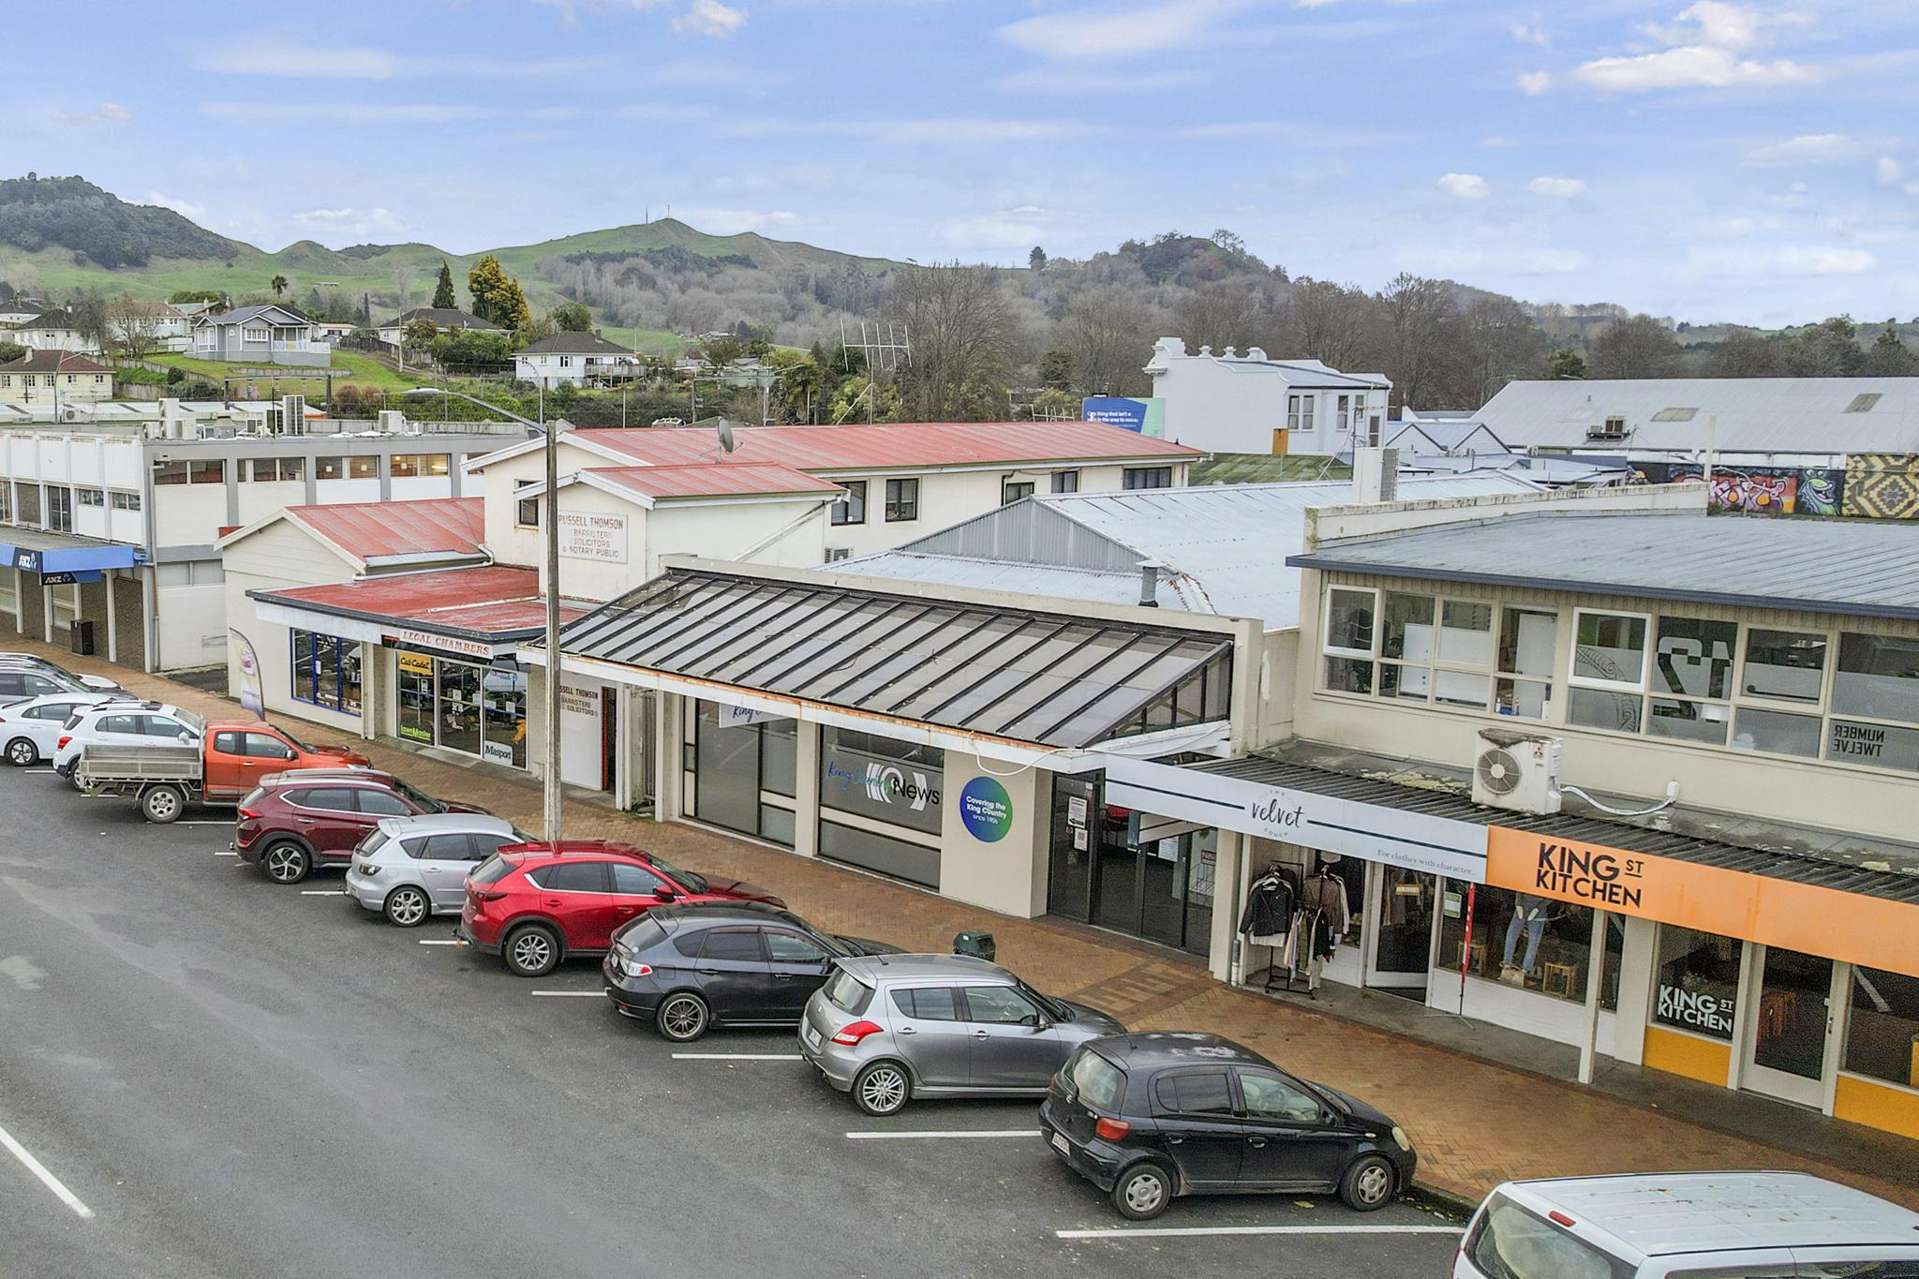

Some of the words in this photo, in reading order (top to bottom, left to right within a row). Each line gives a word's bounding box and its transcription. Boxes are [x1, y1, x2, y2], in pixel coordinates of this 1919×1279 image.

[590, 516, 624, 529] THOMSON
[569, 546, 593, 555] NOTARY
[596, 547, 619, 558] PUBLIC
[402, 630, 432, 645] LEGAL
[435, 636, 490, 656] CHAMBERS
[891, 776, 941, 806] News
[966, 795, 995, 810] Covering
[966, 803, 981, 814] King
[982, 806, 1007, 820] Country
[1252, 798, 1304, 829] velvet
[1391, 852, 1417, 864] clothes
[1419, 857, 1436, 868] with
[1538, 842, 1620, 881] KING
[1625, 859, 1645, 874] ST
[1536, 868, 1642, 909] KITCHEN
[1659, 984, 1717, 1014] KING
[1720, 999, 1735, 1009] ST
[1657, 1002, 1733, 1033] KITCHEN
